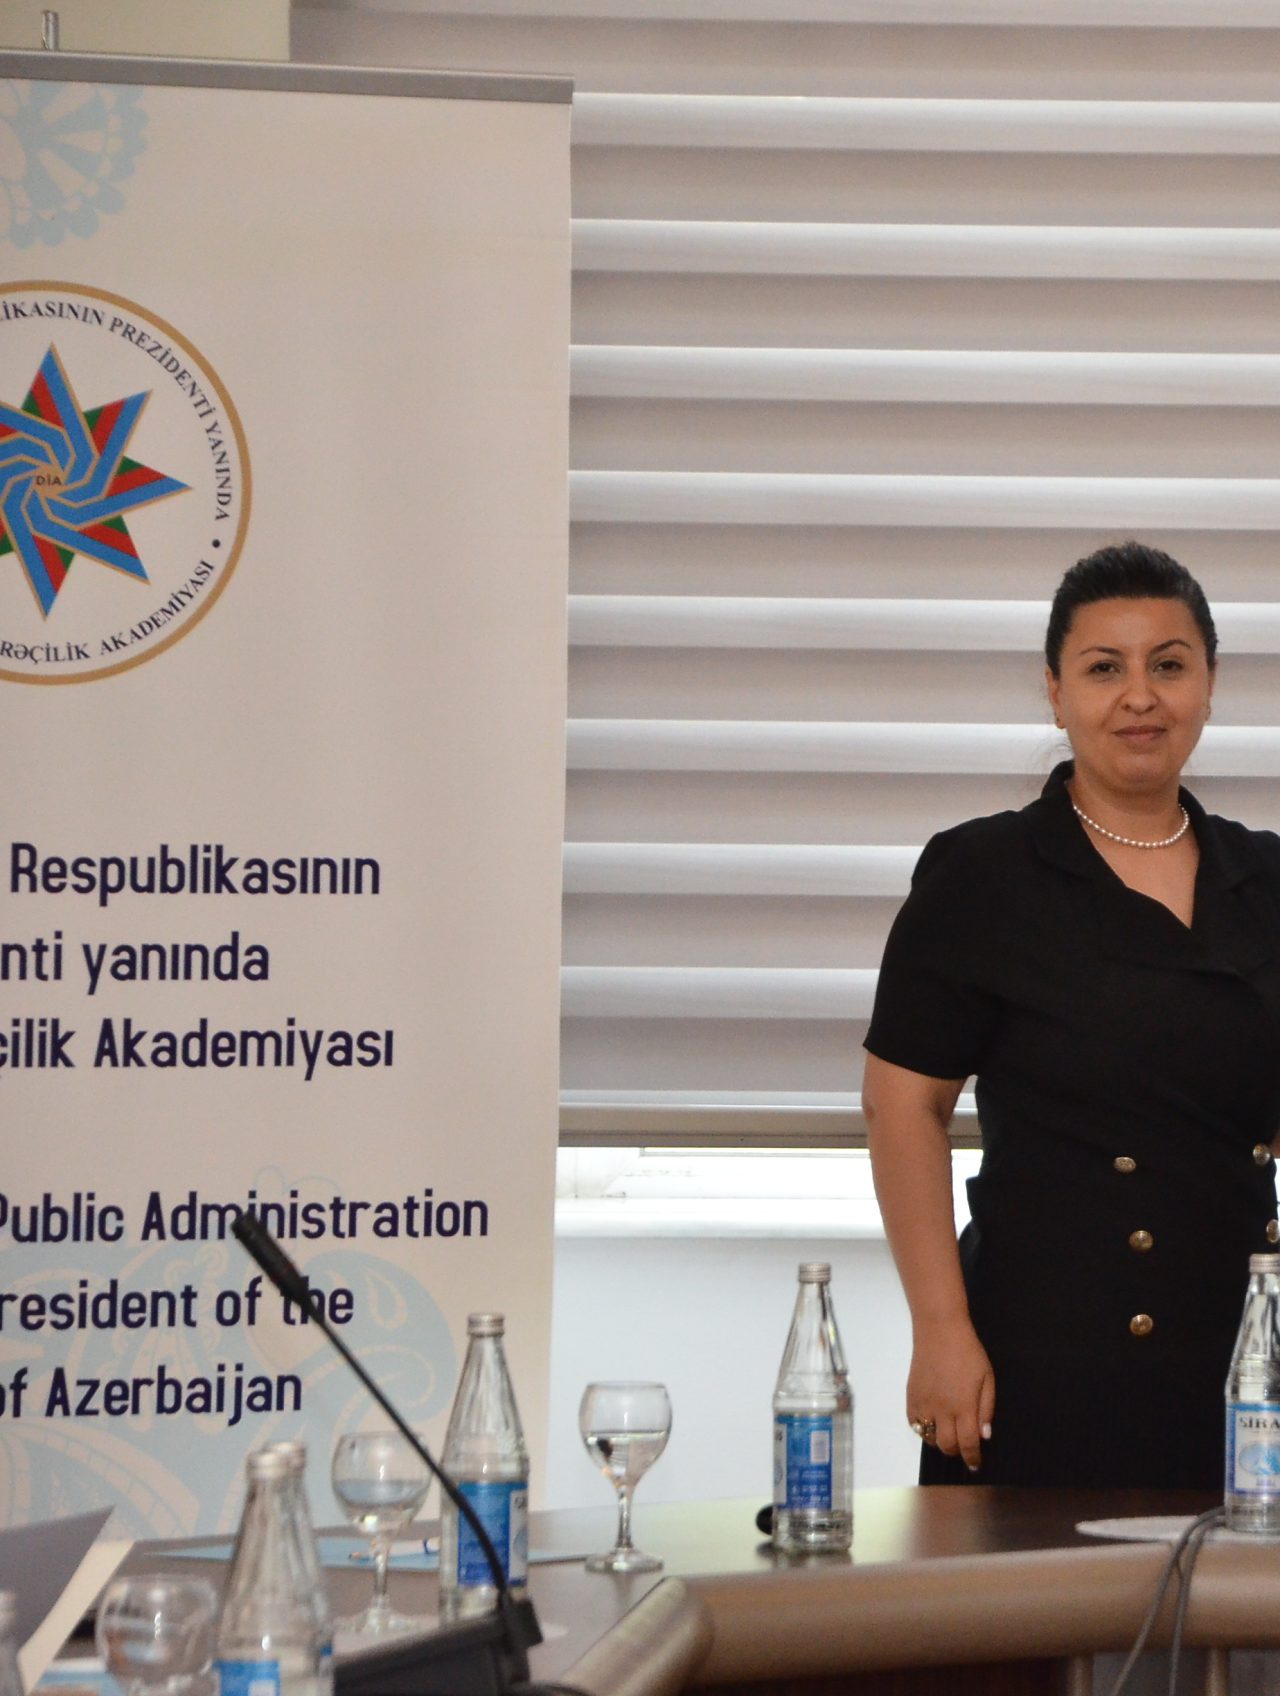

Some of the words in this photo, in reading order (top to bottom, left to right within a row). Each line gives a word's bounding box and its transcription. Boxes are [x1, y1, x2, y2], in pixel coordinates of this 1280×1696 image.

[0, 300, 104, 326] İKASININ
[108, 317, 216, 419] PREZİDENTİ
[205, 420, 232, 522] YANINDA
[36, 473, 62, 486] DİA
[100, 559, 215, 655] AKADEMİYASI
[11, 842, 380, 907] Respublikasının
[0, 931, 63, 981] nti
[82, 932, 269, 995] yanında
[94, 1017, 394, 1081] Akademiyası
[0, 1192, 124, 1243] ublic
[215, 1275, 263, 1327] of
[0, 1366, 28, 1419] f
[45, 1363, 302, 1427] Azerbaijan
